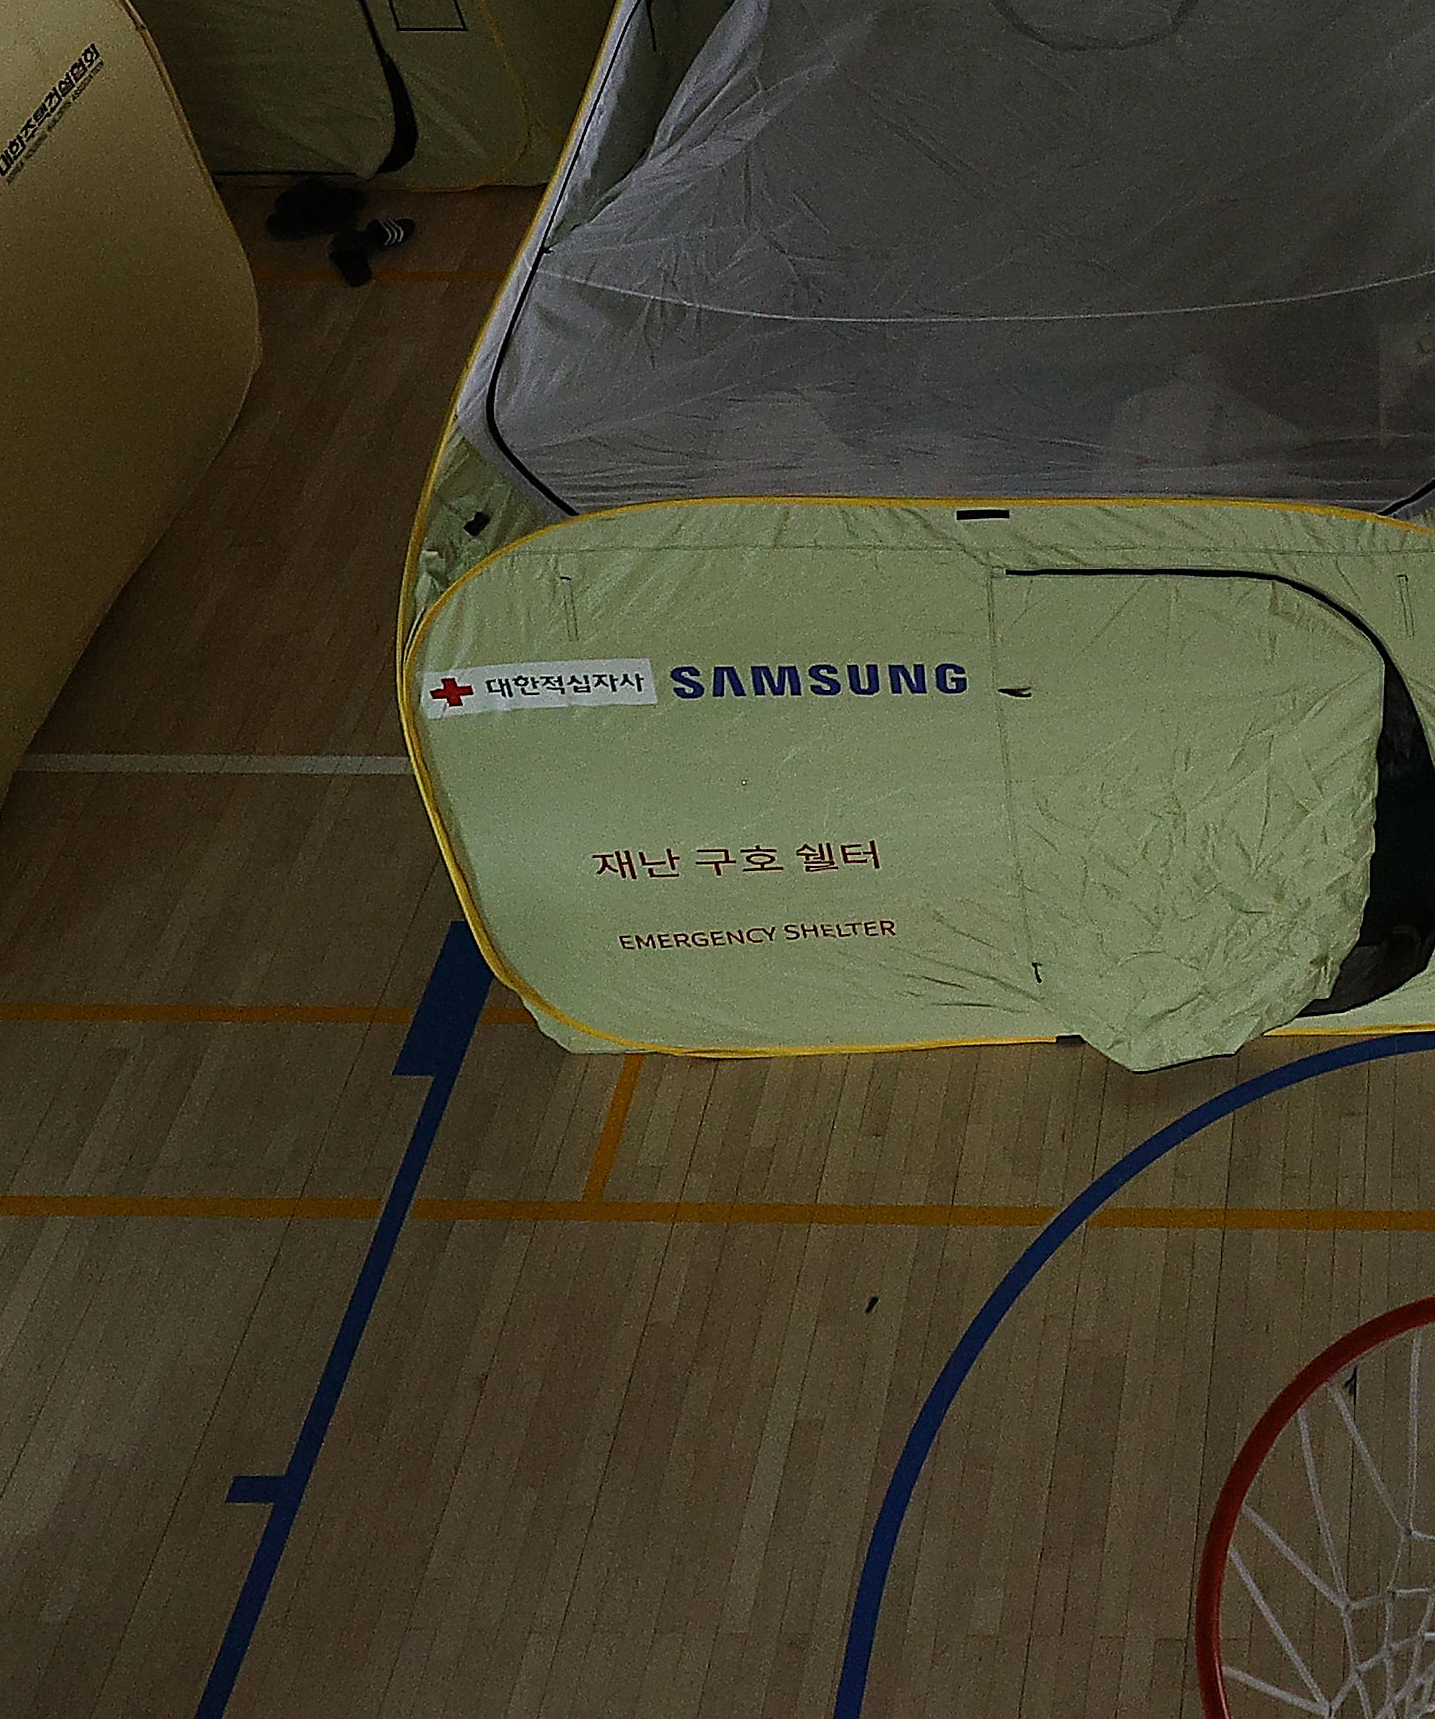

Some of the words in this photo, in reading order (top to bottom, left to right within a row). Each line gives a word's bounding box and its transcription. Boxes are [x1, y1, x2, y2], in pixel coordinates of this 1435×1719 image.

[485, 670, 646, 698] 대한적십자사
[672, 662, 970, 700] SAMSUNG
[592, 848, 681, 882] 재난
[694, 844, 785, 876] 구호
[796, 839, 883, 872] 쉘터
[617, 925, 779, 952] EMERGENCY
[783, 918, 897, 943] SHELTER
